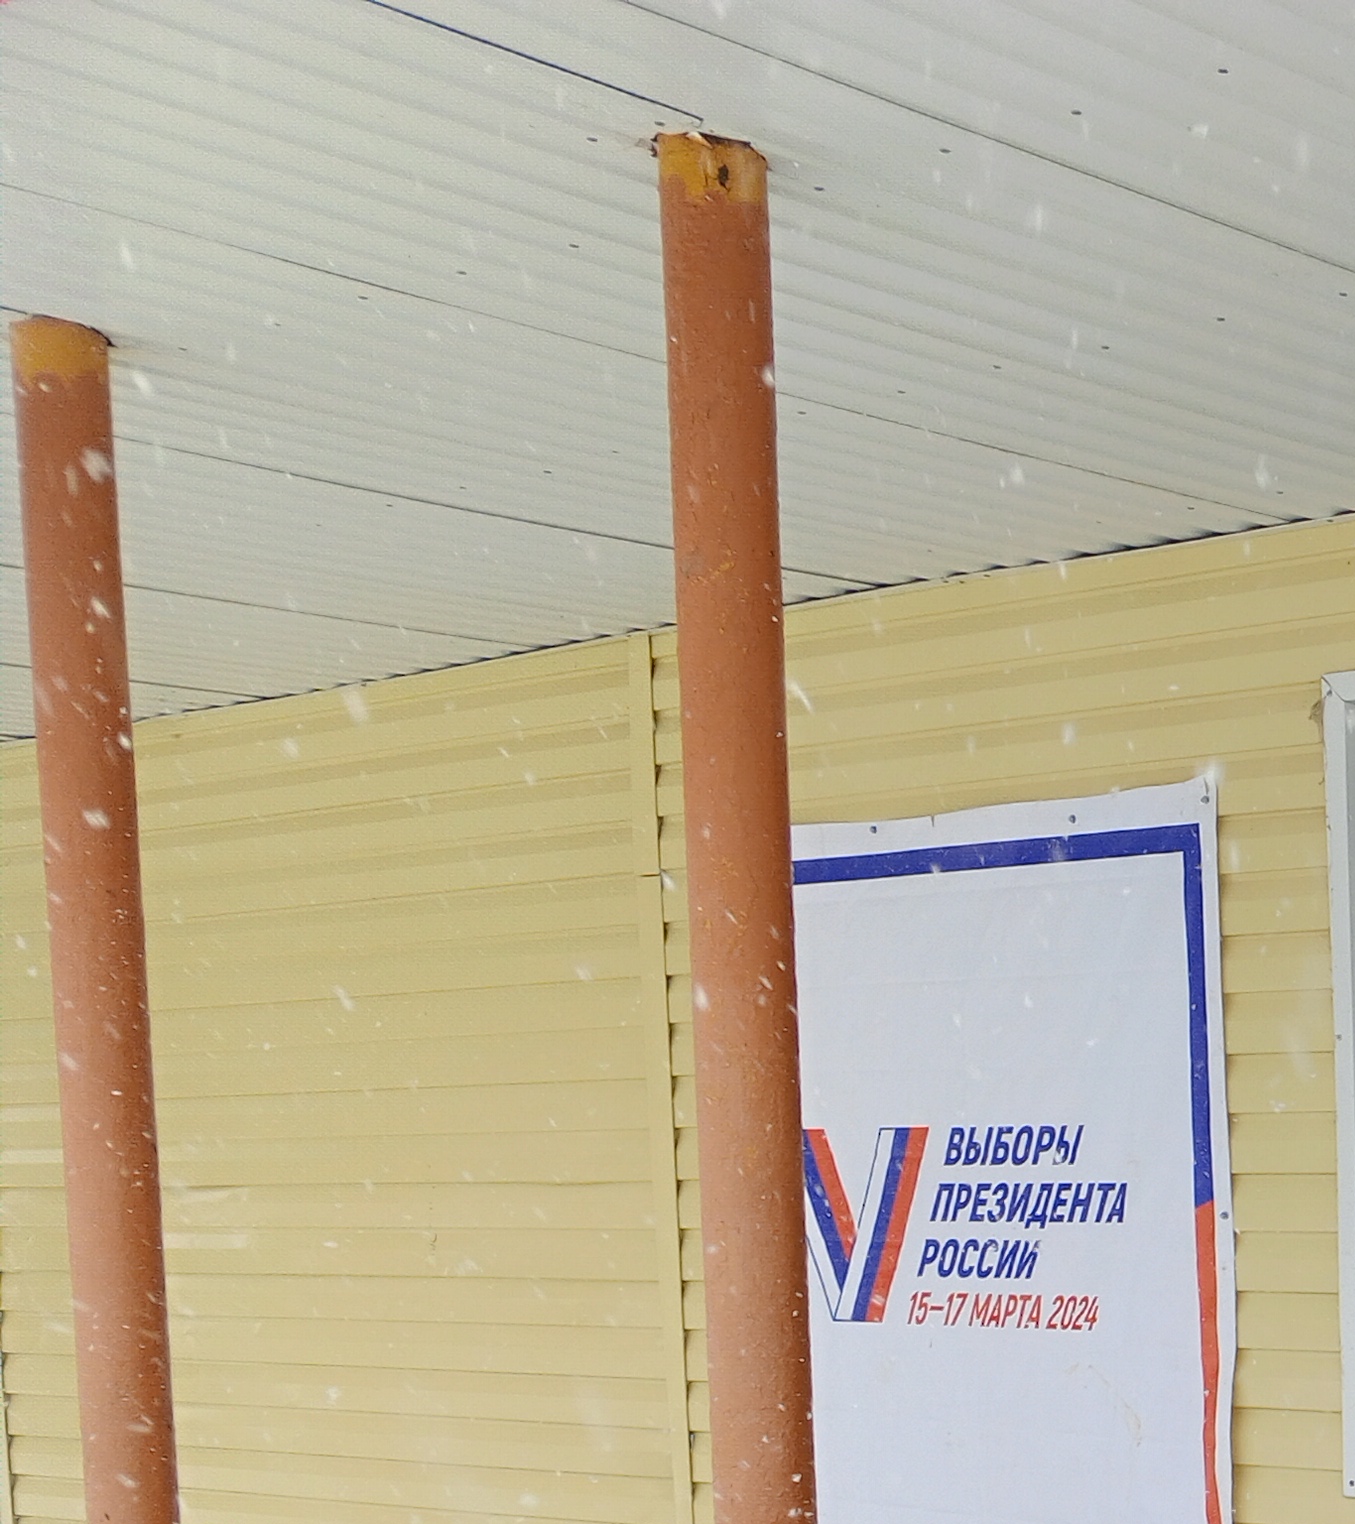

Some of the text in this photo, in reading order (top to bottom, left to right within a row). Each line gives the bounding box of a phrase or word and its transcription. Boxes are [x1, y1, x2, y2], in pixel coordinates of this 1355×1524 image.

[943, 1124, 1085, 1166] ВЫБОРЫ
[929, 1182, 1128, 1229] ПРЕЗИДЕНТА
[917, 1238, 1041, 1279] РОССИИ
[968, 1292, 1042, 1329] МАРТА
[1045, 1295, 1099, 1331] 2024
